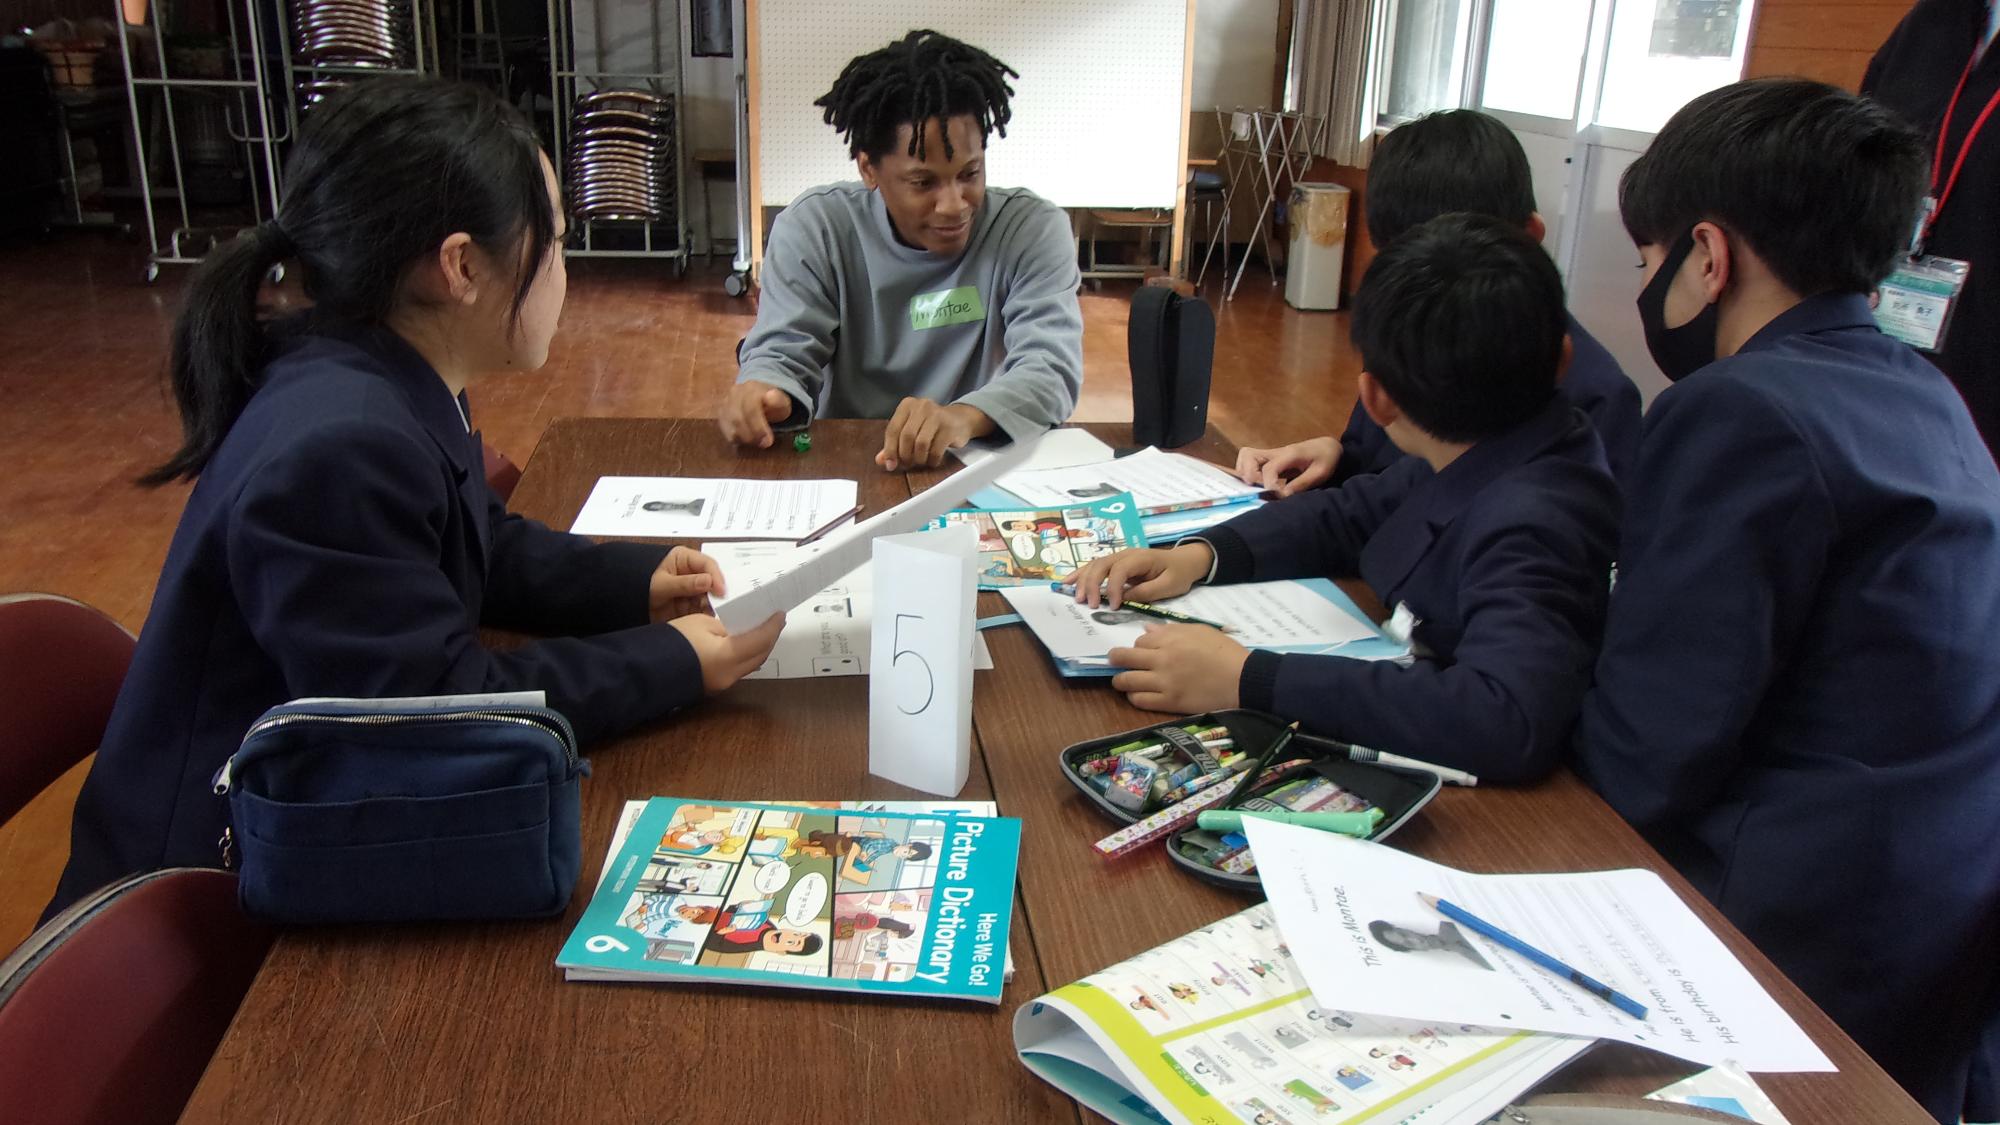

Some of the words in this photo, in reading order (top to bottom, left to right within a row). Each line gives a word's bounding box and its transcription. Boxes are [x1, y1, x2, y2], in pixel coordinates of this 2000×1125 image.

[893, 613, 933, 715] 5
[946, 821, 985, 881] Picture
[1334, 885, 1361, 933] Montae.
[916, 887, 974, 984] Dictionary
[975, 912, 998, 942] Here
[584, 934, 632, 954] 6
[1352, 934, 1367, 944] is
[972, 942, 993, 962] We
[1358, 945, 1383, 967] This
[968, 963, 991, 986] Go!
[1668, 968, 1683, 977] is
[1649, 988, 1676, 1014] from
[1677, 979, 1723, 1024] birthday
[1669, 1016, 1685, 1026] is
[1679, 1027, 1701, 1043] He
[1716, 1026, 1739, 1044] His
